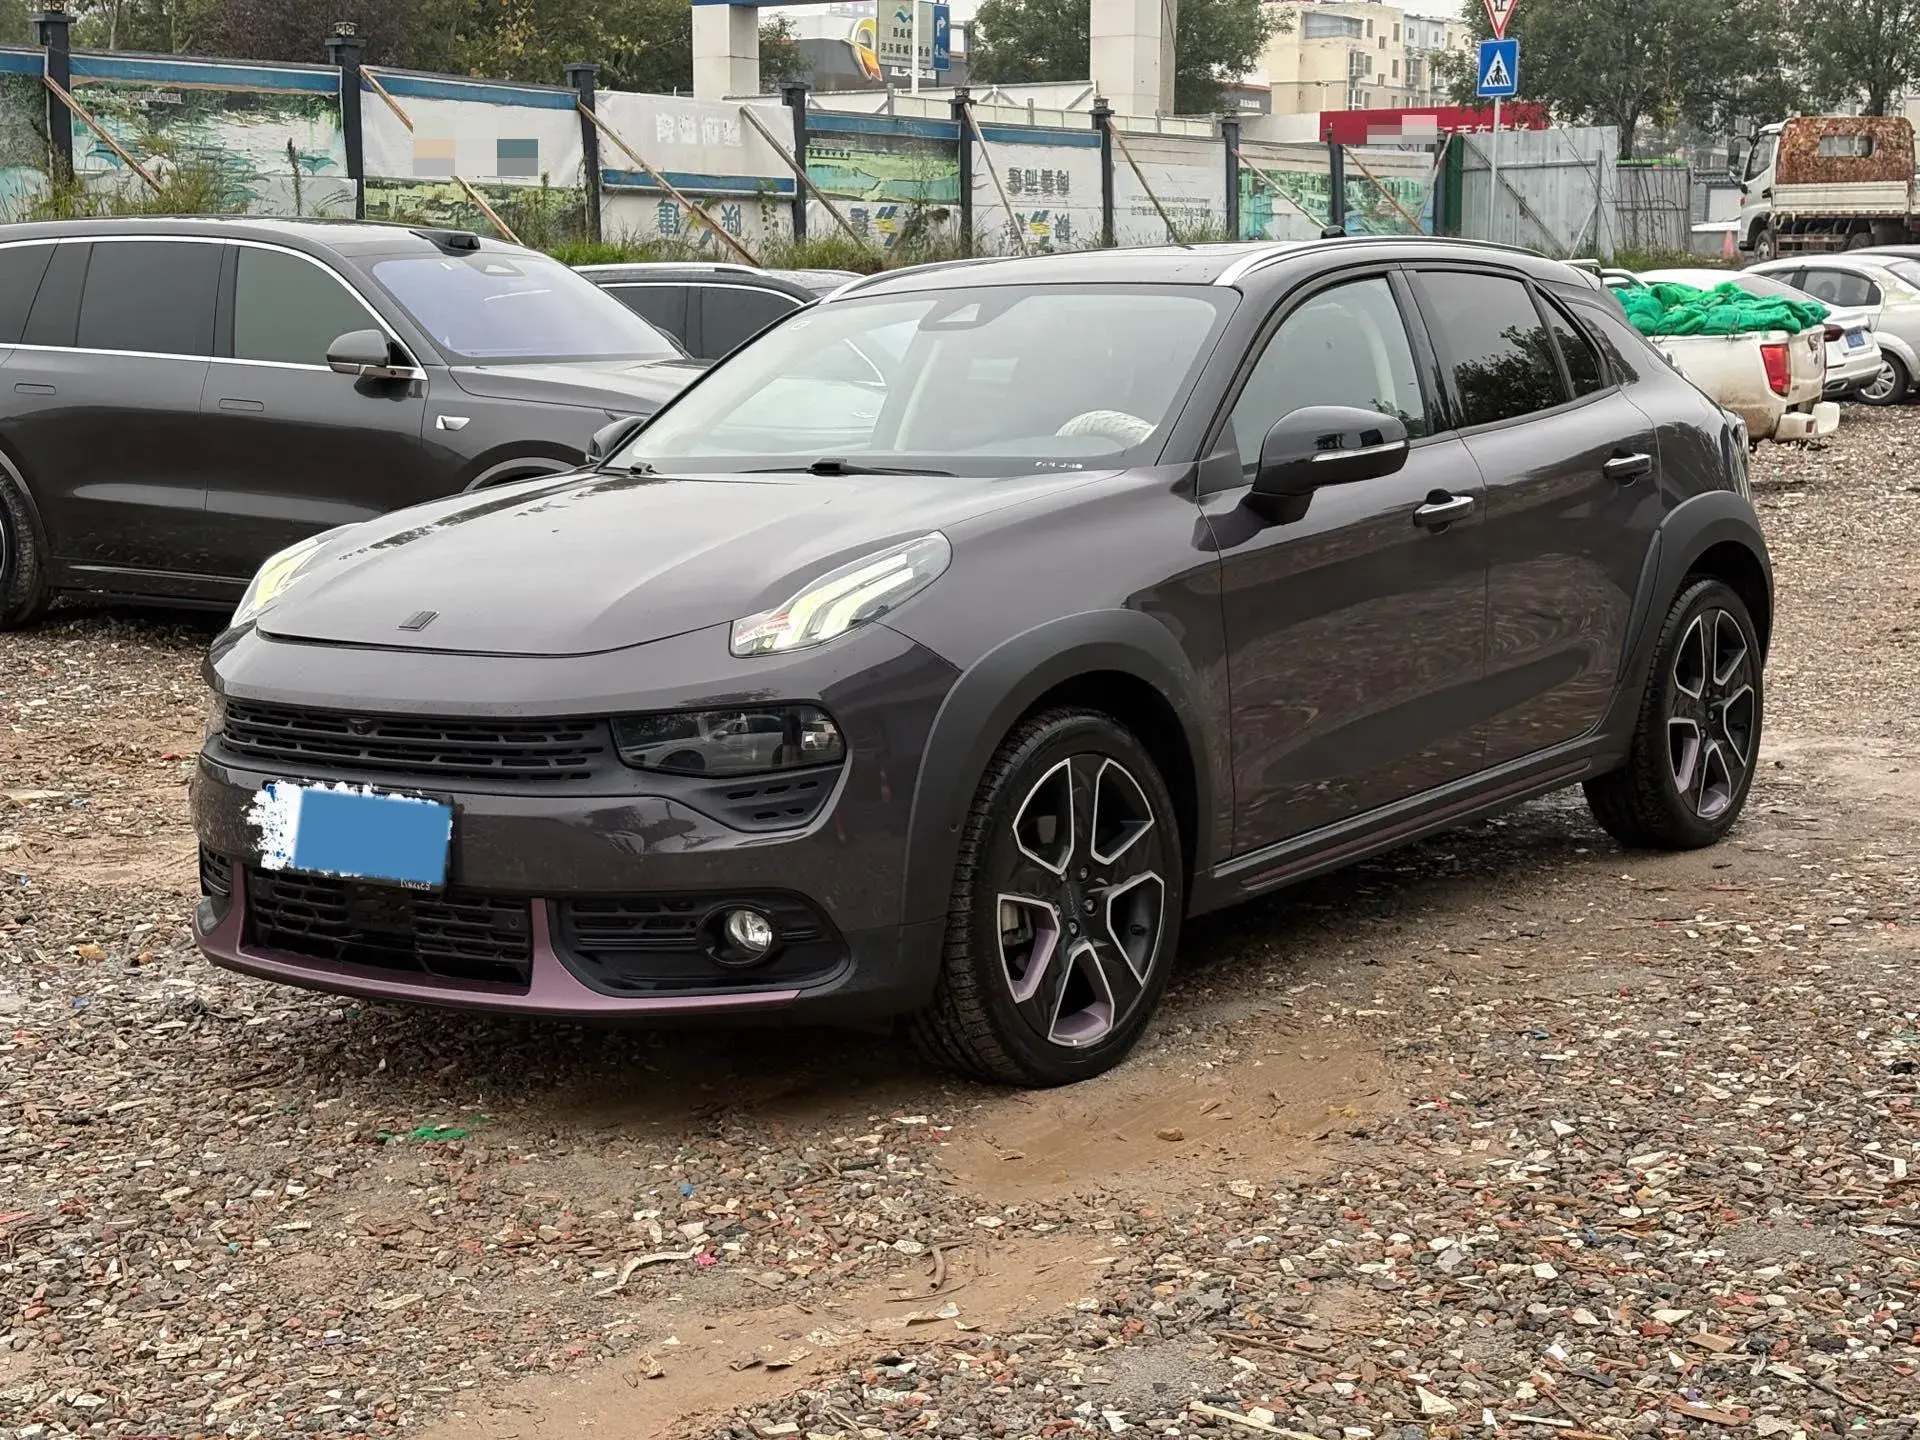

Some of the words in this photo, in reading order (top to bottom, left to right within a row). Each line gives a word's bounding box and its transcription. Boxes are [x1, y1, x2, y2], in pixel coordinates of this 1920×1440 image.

[893, 27, 914, 39] 西咸新
[881, 42, 931, 58] 沣东新城委会
